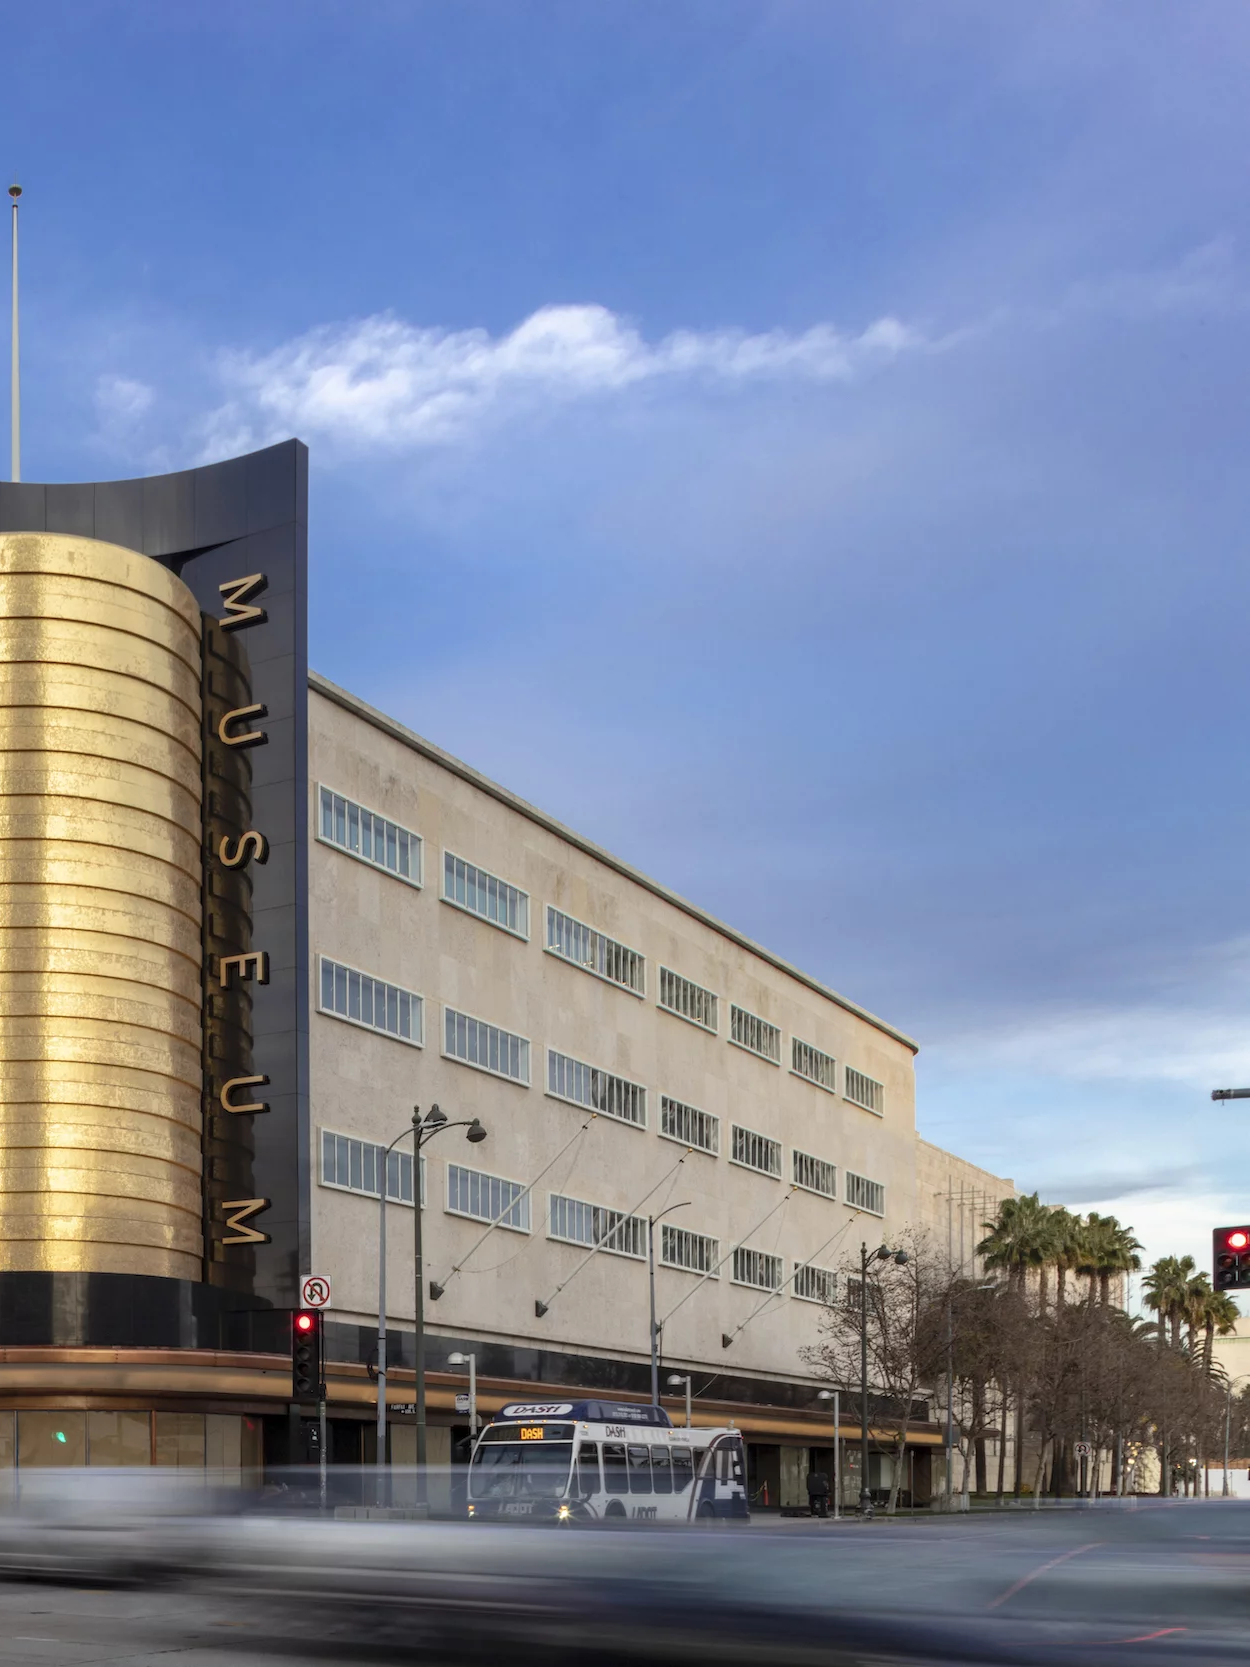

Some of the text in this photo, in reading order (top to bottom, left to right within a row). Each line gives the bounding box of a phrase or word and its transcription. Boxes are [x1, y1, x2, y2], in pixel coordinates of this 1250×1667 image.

[217, 572, 270, 1246] MUSEUM
[512, 1405, 562, 1414] DASH
[521, 1427, 544, 1440] DASH
[606, 1426, 626, 1438] DASH
